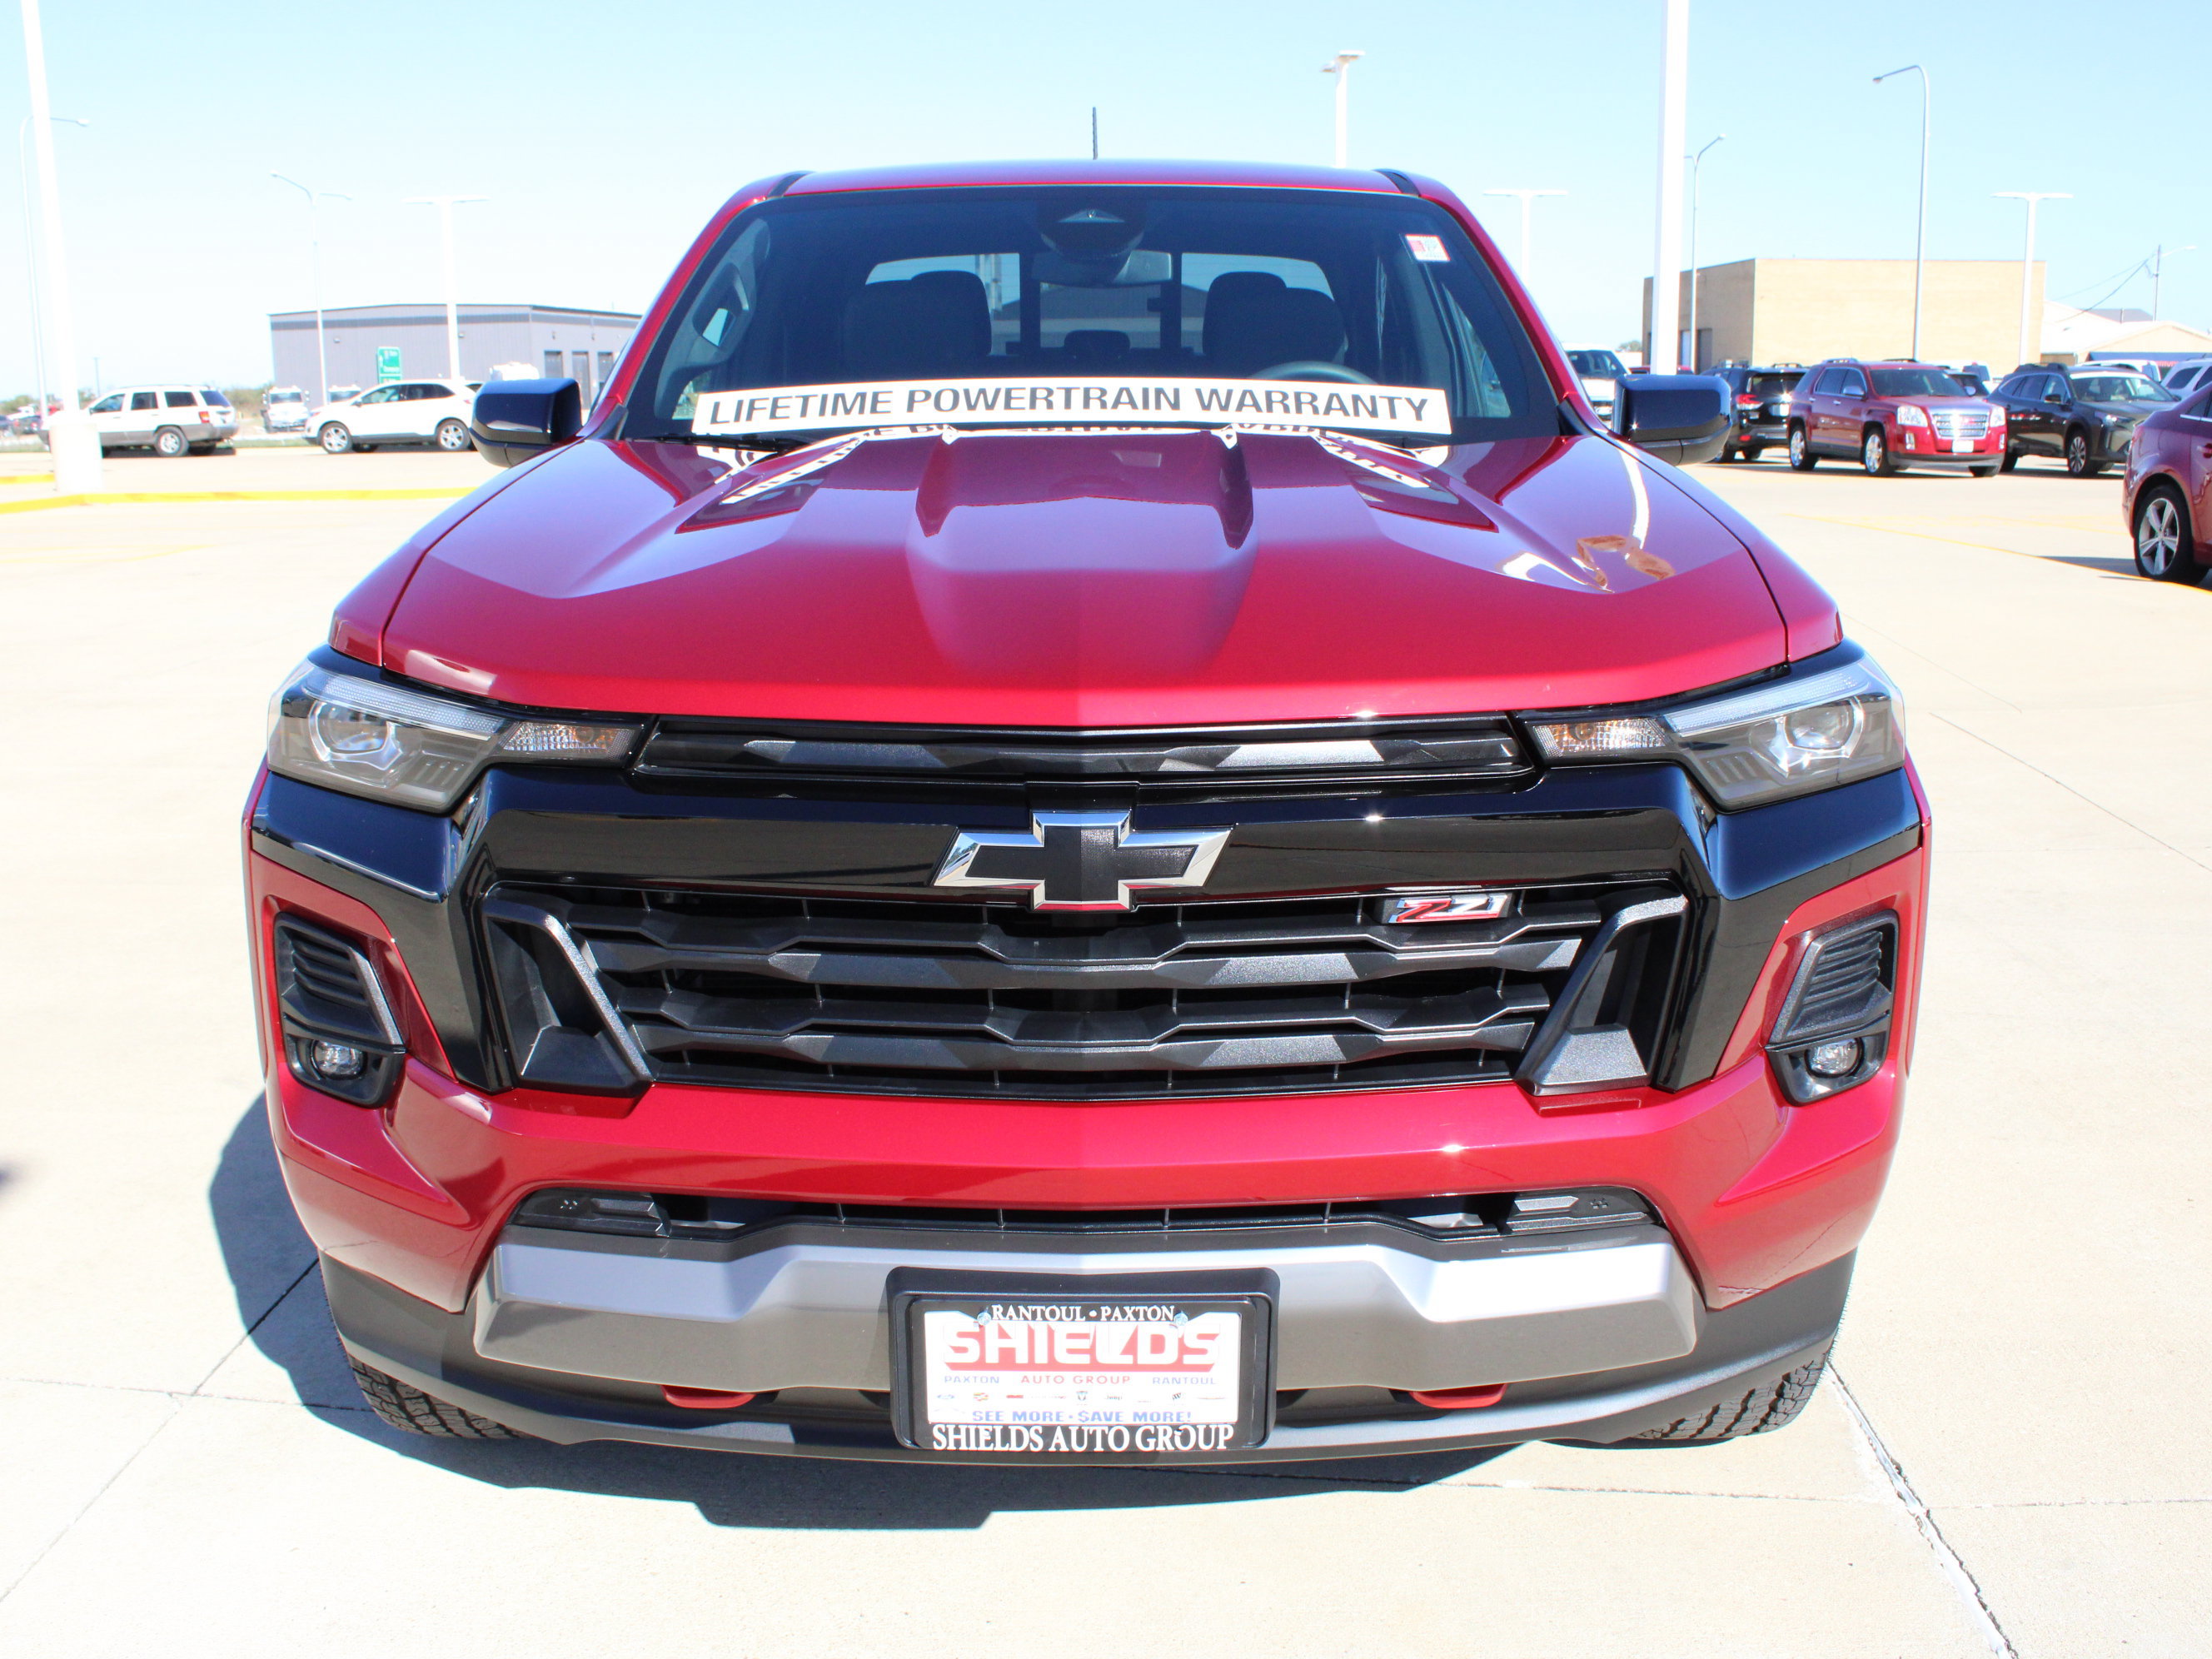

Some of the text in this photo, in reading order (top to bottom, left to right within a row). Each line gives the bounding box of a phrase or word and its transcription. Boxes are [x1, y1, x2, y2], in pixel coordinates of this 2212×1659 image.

[710, 386, 1428, 424] LIFETIME POWERTRAIN WARRANTY
[1388, 894, 1507, 924] Z71
[991, 1304, 1174, 1322] RANTOUL PAXTON
[944, 1324, 1221, 1373] SHIELDS
[944, 1375, 1216, 1385] PAXTON AUTO GROUP RANTOUL
[972, 1411, 1004, 1422] SEE
[1012, 1411, 1064, 1422] MORE
[1133, 1412, 1192, 1422] MORE!
[932, 1424, 1234, 1452] SHIELDS AUTO GROUP
